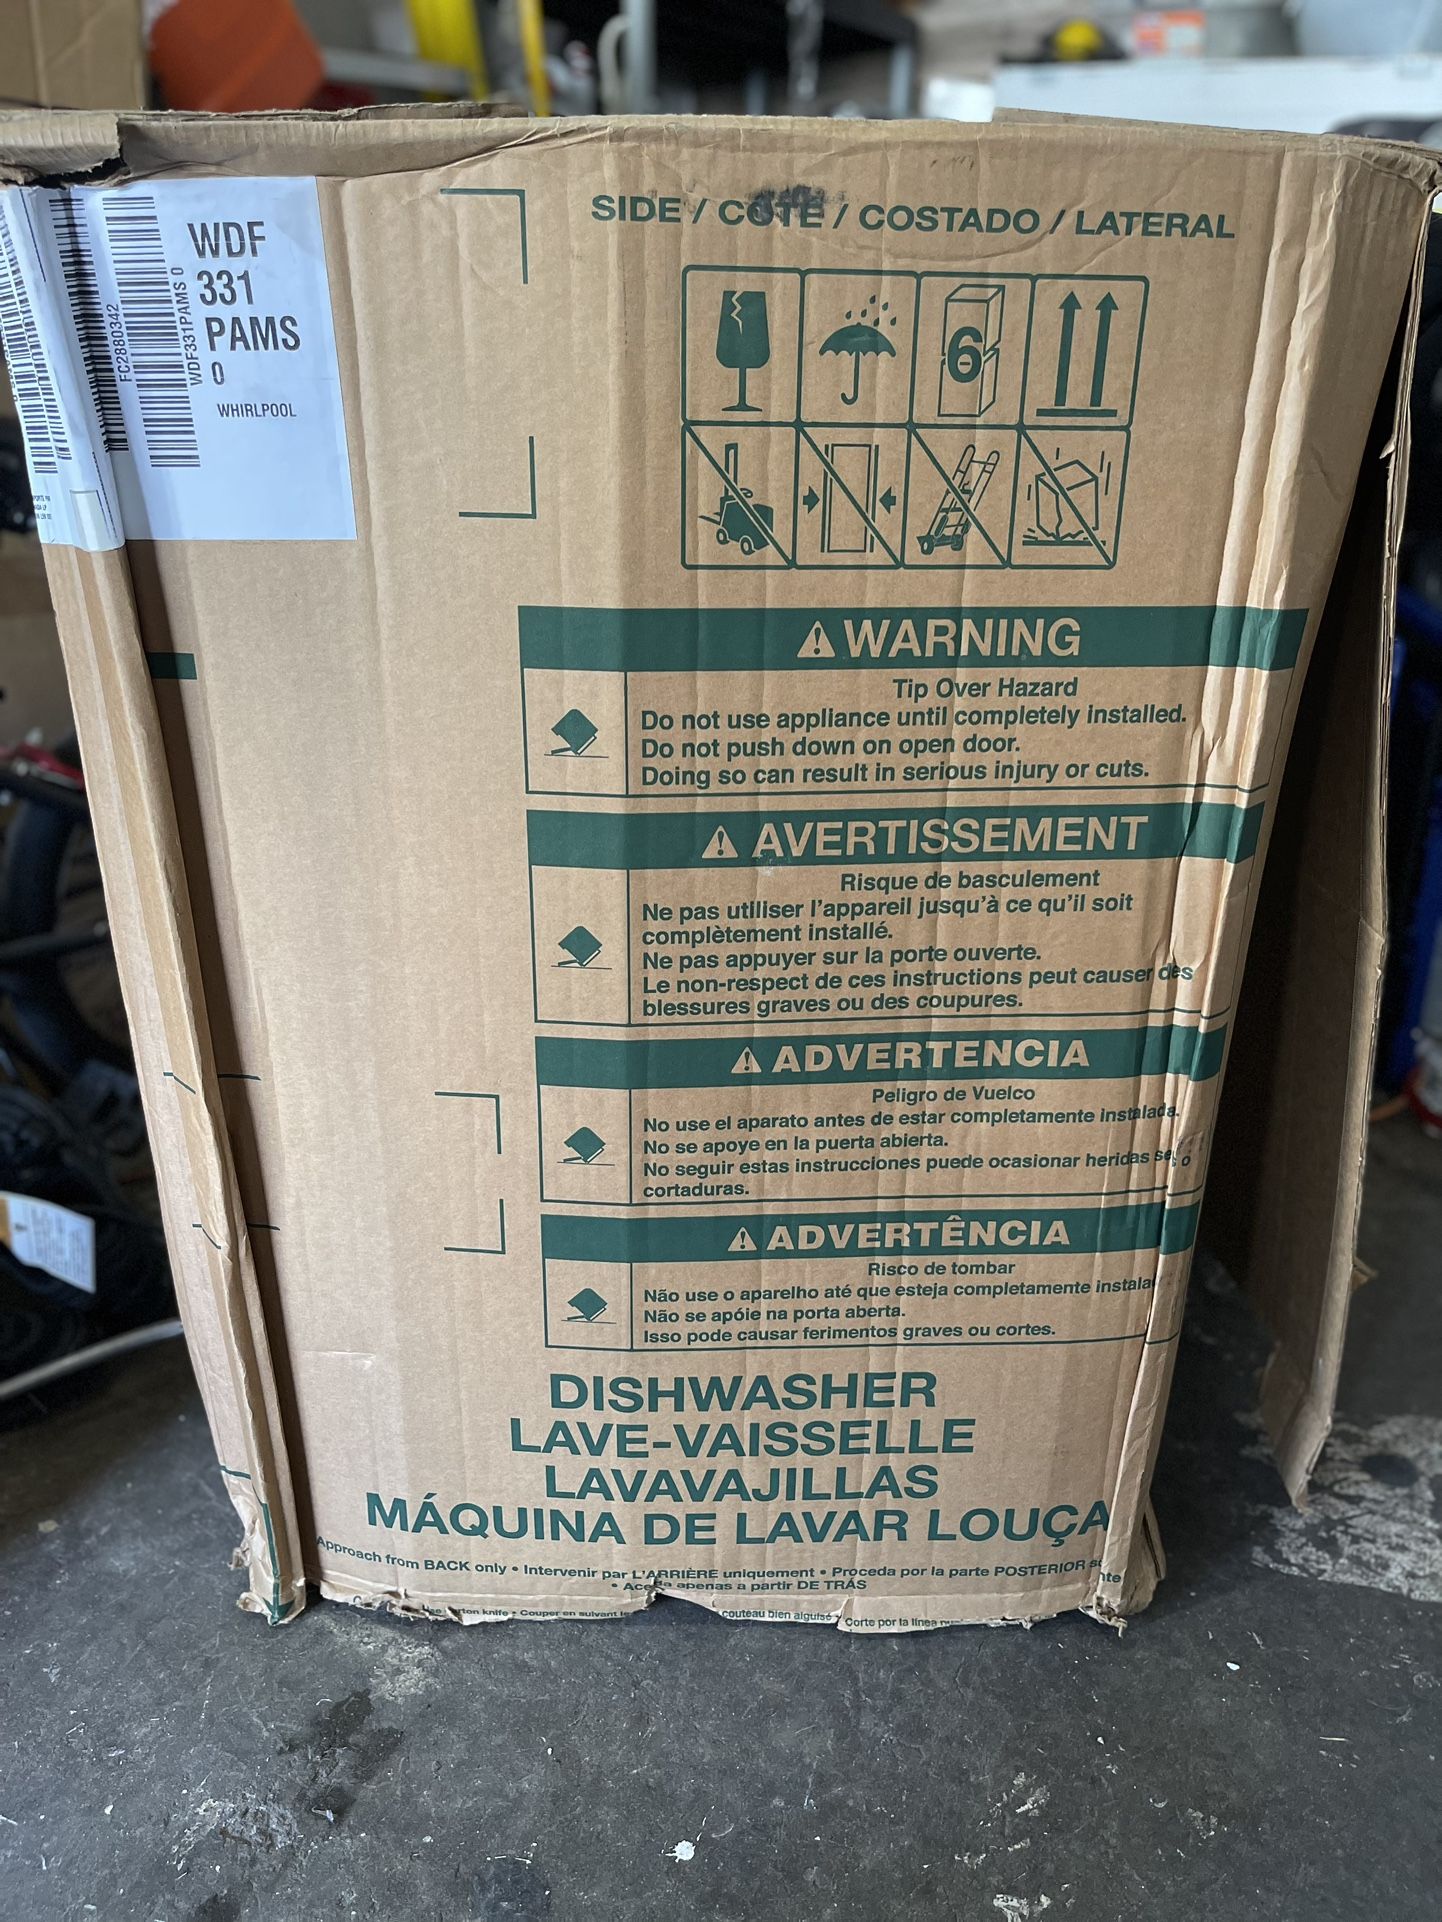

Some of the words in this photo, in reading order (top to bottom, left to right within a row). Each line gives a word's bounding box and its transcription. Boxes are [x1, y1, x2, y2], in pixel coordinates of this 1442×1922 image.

[592, 194, 680, 223] SIDE
[859, 205, 1039, 234] COSTADO
[1076, 211, 1235, 238] LATERAL
[187, 221, 265, 258] WDF
[197, 270, 253, 305] 331
[106, 303, 132, 382] FC2880342
[175, 280, 203, 386] WDF331PAMS
[205, 316, 300, 351] PAMS
[212, 362, 224, 385] 0
[217, 403, 296, 417] WHIRLPOOL
[844, 618, 1080, 657] WARNING
[893, 679, 928, 703] Tip
[936, 678, 991, 698] Over
[998, 677, 1078, 697] Hazard
[642, 711, 673, 730] Do
[682, 711, 720, 729] not
[728, 713, 770, 729] use
[777, 708, 890, 733] appliance
[898, 706, 947, 726] until
[955, 705, 1080, 729] completely
[1087, 704, 1186, 723] installed.
[642, 739, 674, 758] Do
[682, 739, 720, 757] not
[727, 737, 784, 762] push
[792, 737, 854, 756] down
[863, 739, 891, 754] on
[899, 738, 954, 758] open
[963, 734, 1020, 752] door.
[642, 766, 710, 789] Doing
[718, 770, 746, 784] so
[754, 769, 794, 784] can
[803, 763, 868, 783] result
[876, 763, 895, 781] in
[903, 761, 987, 781] serious
[995, 760, 1059, 783] injury
[1066, 763, 1089, 778] or
[1096, 760, 1148, 777] cuts.
[752, 816, 1148, 858] AVERTISSEMENT
[841, 873, 918, 895] Risque
[925, 871, 951, 889] de
[958, 870, 1100, 888] basculement
[643, 904, 673, 921] Ne
[680, 906, 719, 925] pas
[728, 901, 804, 919] utiliser
[810, 898, 911, 920] l’appareil
[918, 895, 999, 919] jusqu’à
[1006, 899, 1032, 913] ce
[1038, 894, 1085, 916] qu’il
[1092, 893, 1133, 911] soit
[642, 925, 802, 948] complètement
[809, 921, 892, 941] installé.
[643, 952, 673, 969] Ne
[680, 955, 719, 973] pas
[726, 952, 816, 971] appuyer
[823, 951, 858, 965] sur
[866, 947, 883, 963] la
[890, 946, 947, 967] porte
[954, 944, 1041, 961] ouverte.
[644, 977, 670, 993] Le
[677, 973, 809, 995] non-respect
[815, 972, 842, 989] de
[848, 974, 885, 988] ces
[893, 968, 1022, 987] instructions
[1029, 968, 1077, 988] peut
[1084, 966, 1154, 983] causer
[643, 999, 750, 1016] blessures
[757, 999, 830, 1017] graves
[837, 998, 863, 1011] ou
[871, 993, 909, 1010] des
[917, 994, 1022, 1012] coupures.
[772, 1039, 1089, 1072] ADVERTENCIA
[873, 1088, 937, 1105] Peligro
[944, 1087, 966, 1101] de
[972, 1086, 1035, 1100] Vuelco
[644, 1118, 669, 1132] No
[676, 1120, 710, 1131] use
[715, 1116, 731, 1130] el
[737, 1115, 808, 1132] aparato
[814, 1114, 865, 1127] antes
[871, 1111, 893, 1126] de
[899, 1111, 946, 1125] estar
[951, 1109, 1095, 1127] completamente
[1100, 1101, 1180, 1122] instalada.
[644, 1140, 669, 1154] No
[675, 1143, 697, 1153] se
[703, 1140, 760, 1156] apoye
[765, 1140, 787, 1150] en
[794, 1136, 809, 1150] la
[816, 1136, 874, 1153] puerta
[880, 1133, 948, 1147] abierta.
[644, 1163, 669, 1176] No
[675, 1161, 734, 1179] seguir
[740, 1160, 789, 1174] estas
[796, 1156, 920, 1172] instrucciones
[927, 1155, 983, 1172] puede
[989, 1154, 1080, 1168] ocasionar
[1086, 1149, 1150, 1168] heridas
[643, 1183, 749, 1197] cortaduras.
[767, 1215, 1069, 1250] ADVERTÊNCIA
[868, 1263, 918, 1276] Risco
[924, 1262, 946, 1275] de
[951, 1261, 1015, 1275] tombar
[645, 1289, 679, 1302] Não
[686, 1292, 718, 1301] use
[724, 1291, 734, 1301] o
[740, 1286, 818, 1303] aparelho
[824, 1284, 852, 1298] até
[857, 1287, 890, 1300] que
[895, 1283, 948, 1299] esteja
[954, 1282, 1091, 1298] completamente
[645, 1310, 679, 1323] Não
[685, 1312, 706, 1322] se
[711, 1308, 761, 1324] apóie
[767, 1310, 787, 1320] na
[794, 1307, 839, 1323] porta
[845, 1305, 905, 1318] aberta.
[644, 1331, 681, 1343] Isso
[688, 1329, 732, 1345] pode
[737, 1330, 798, 1341] causar
[803, 1326, 897, 1339] ferimentos
[903, 1327, 962, 1340] graves
[968, 1327, 990, 1336] ou
[996, 1324, 1055, 1336] cortes.
[550, 1372, 936, 1413] DISHWASHER
[511, 1418, 976, 1458] LAVE-VAISSELLE
[546, 1465, 938, 1502] LAVAVAJILLAS
[366, 1490, 627, 1545] MÁQUINA
[644, 1513, 716, 1545] DE
[736, 1510, 908, 1544] LAVAR
[926, 1499, 1110, 1548] LOUÇA
[316, 1535, 382, 1563] Approach
[386, 1554, 419, 1569] from
[424, 1560, 470, 1571] BACK
[475, 1563, 506, 1575] only
[524, 1565, 597, 1577] Intervenir
[602, 1571, 628, 1580] par
[631, 1566, 720, 1580] L’ARRIÈRE
[723, 1568, 814, 1580] uniquement
[832, 1566, 896, 1577] Proceda
[901, 1569, 927, 1578] por
[931, 1566, 944, 1576] la
[949, 1567, 989, 1578] parte
[995, 1560, 1085, 1576] POSTERIOR
[751, 1581, 793, 1592] partir
[798, 1581, 819, 1589] DE
[824, 1578, 866, 1590] TRÁS
